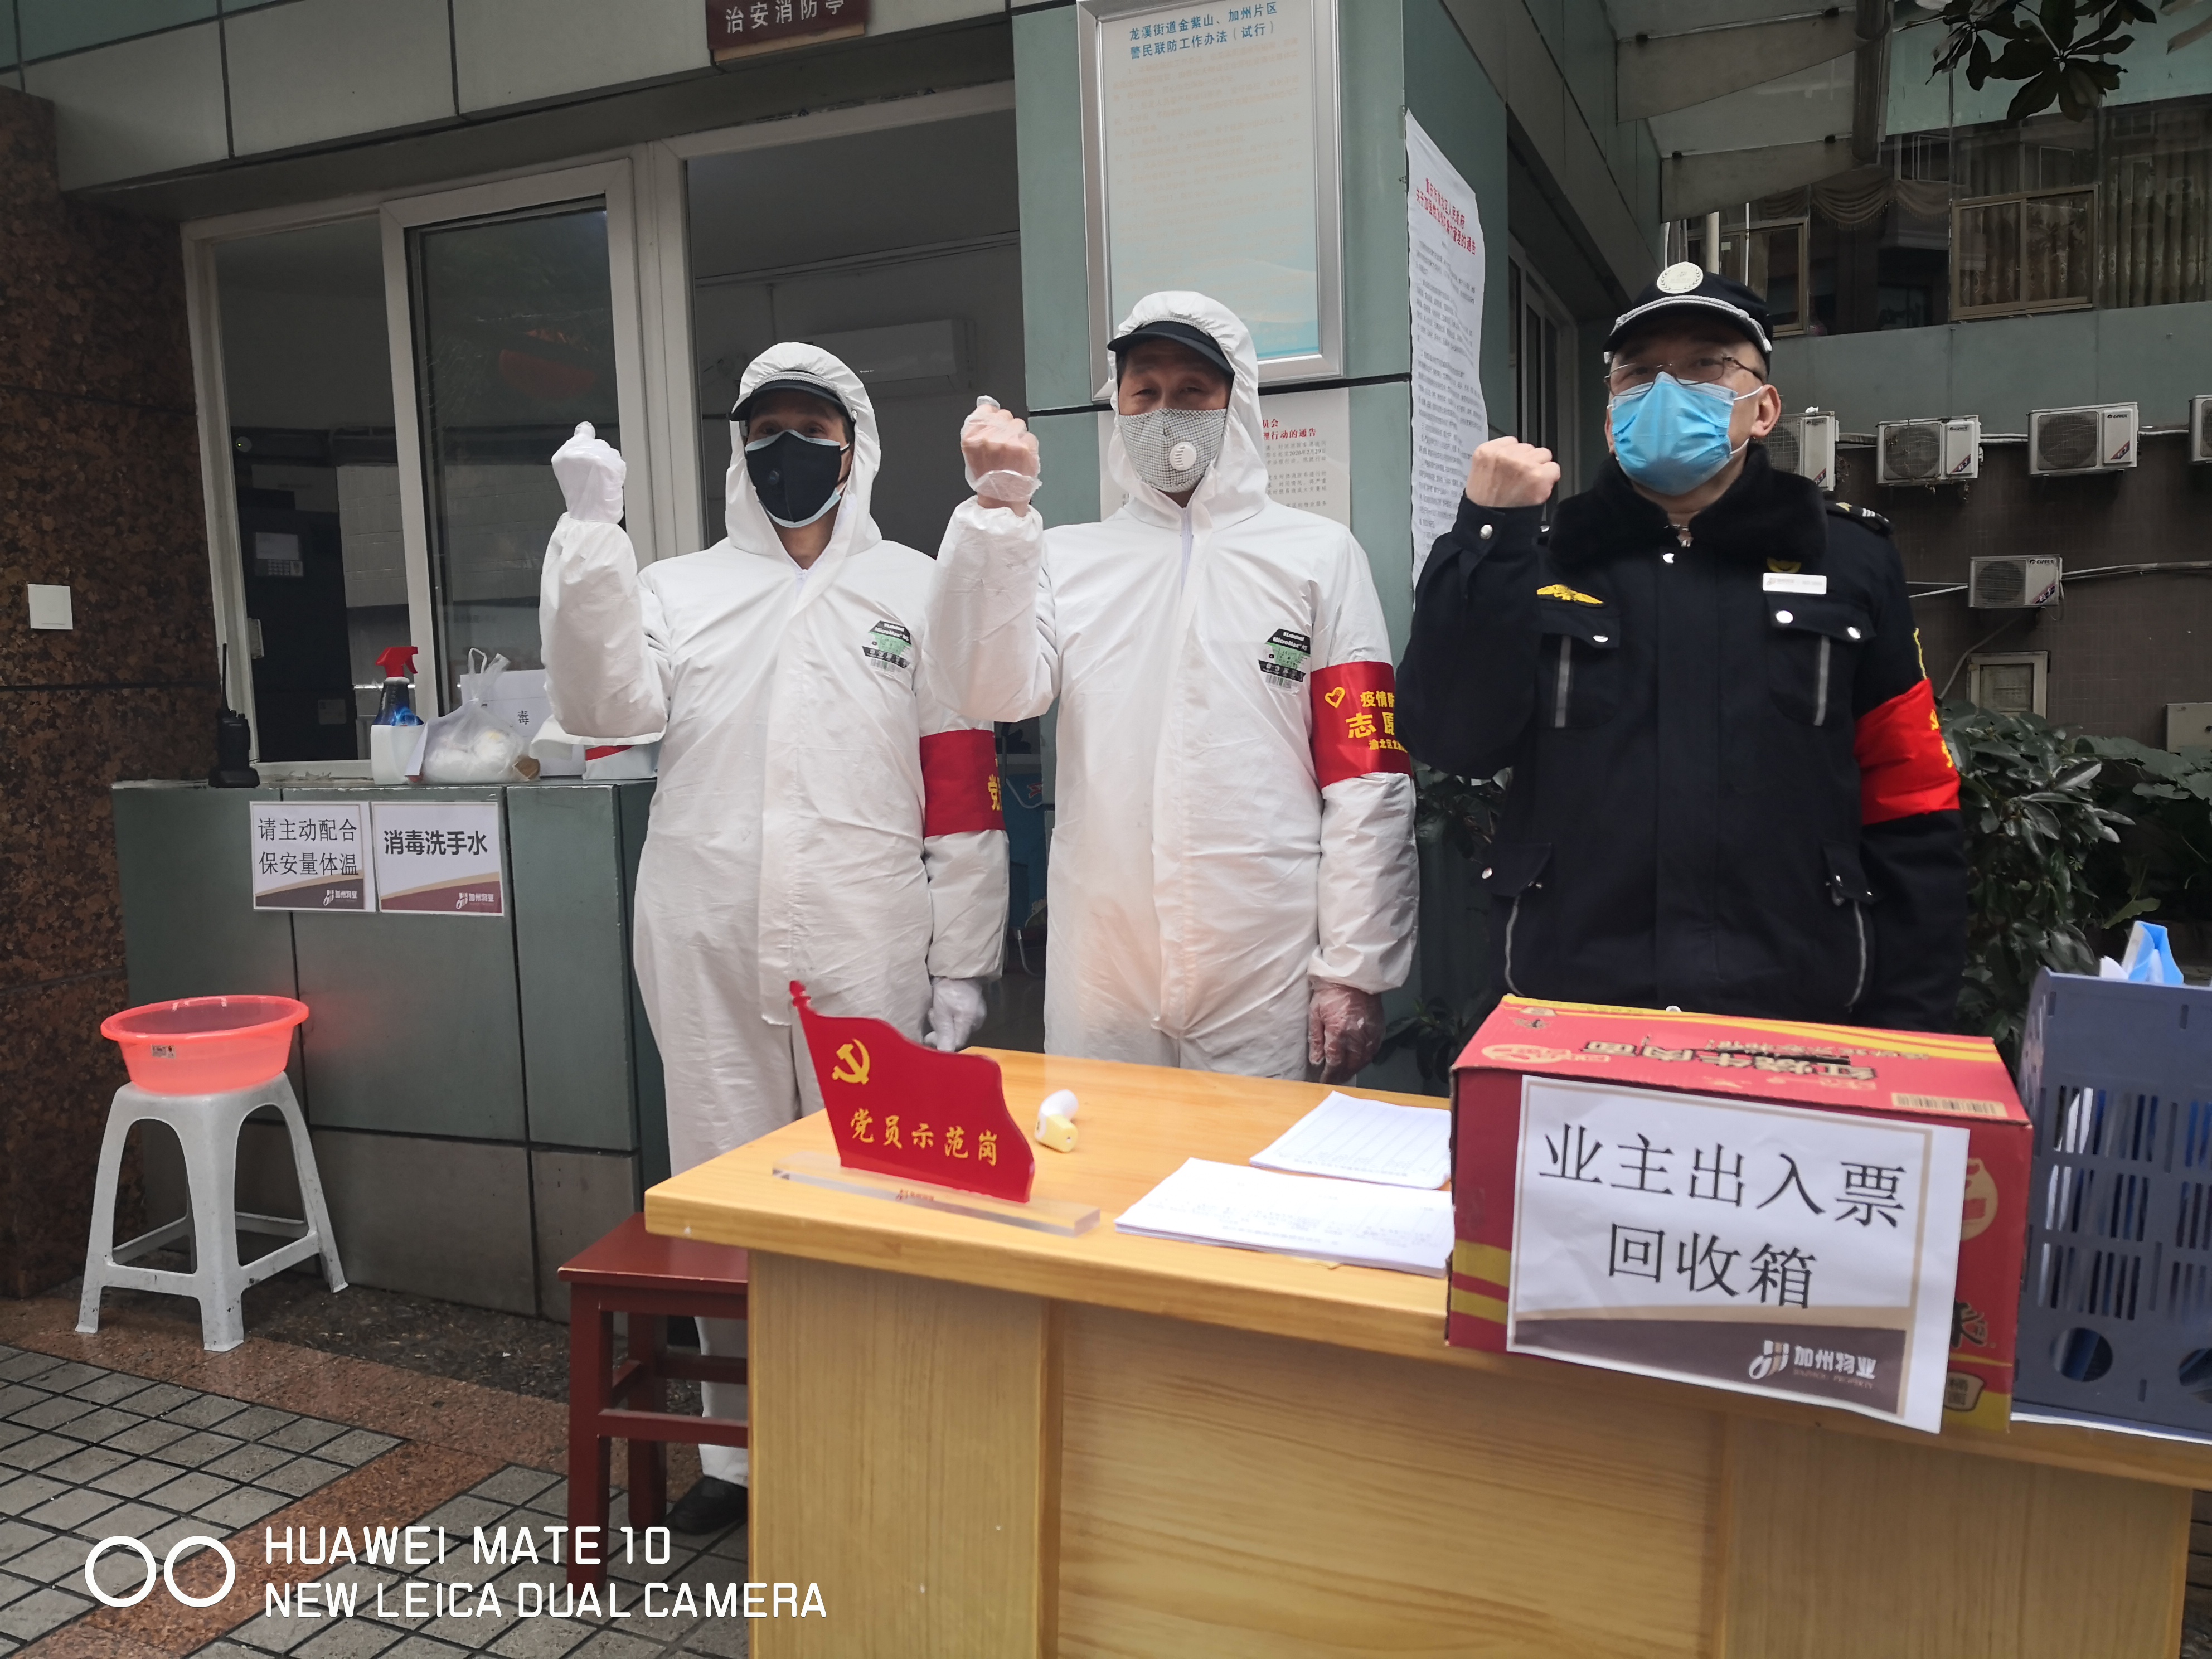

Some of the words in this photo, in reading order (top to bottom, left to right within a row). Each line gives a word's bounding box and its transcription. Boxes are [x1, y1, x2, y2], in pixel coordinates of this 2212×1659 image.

[1129, 1, 1277, 41] 龙溪街道金紫山、加州片区
[258, 818, 357, 842] 请主动配合
[384, 830, 488, 856] 消毒洗手水
[259, 851, 359, 876] 保安量体温
[850, 1107, 998, 1167] 党员示范岗
[1538, 1123, 1907, 1229] 业主出入票
[1608, 1223, 1817, 1310] 回收箱
[1793, 1345, 1877, 1380] 加州物业
